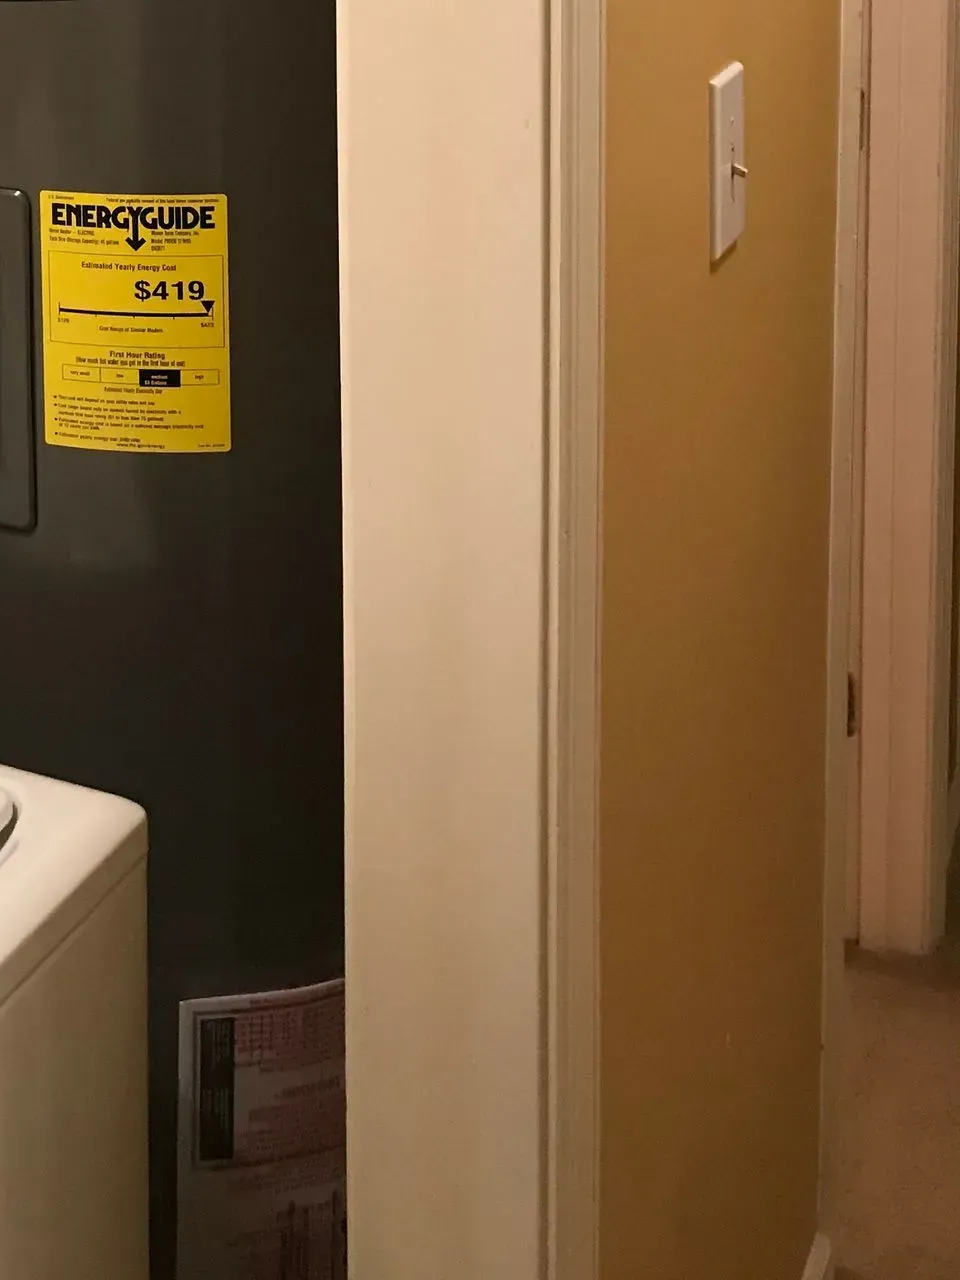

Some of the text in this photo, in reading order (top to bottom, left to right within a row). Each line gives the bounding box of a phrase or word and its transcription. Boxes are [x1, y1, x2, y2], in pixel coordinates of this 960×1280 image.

[51, 202, 216, 230] ENERGYGUIDE
[81, 260, 113, 270] Estimated
[114, 263, 136, 272] Yearly
[137, 263, 160, 272] Energy
[134, 280, 205, 302] $419
[109, 350, 124, 358] First
[144, 352, 166, 360] Rating
